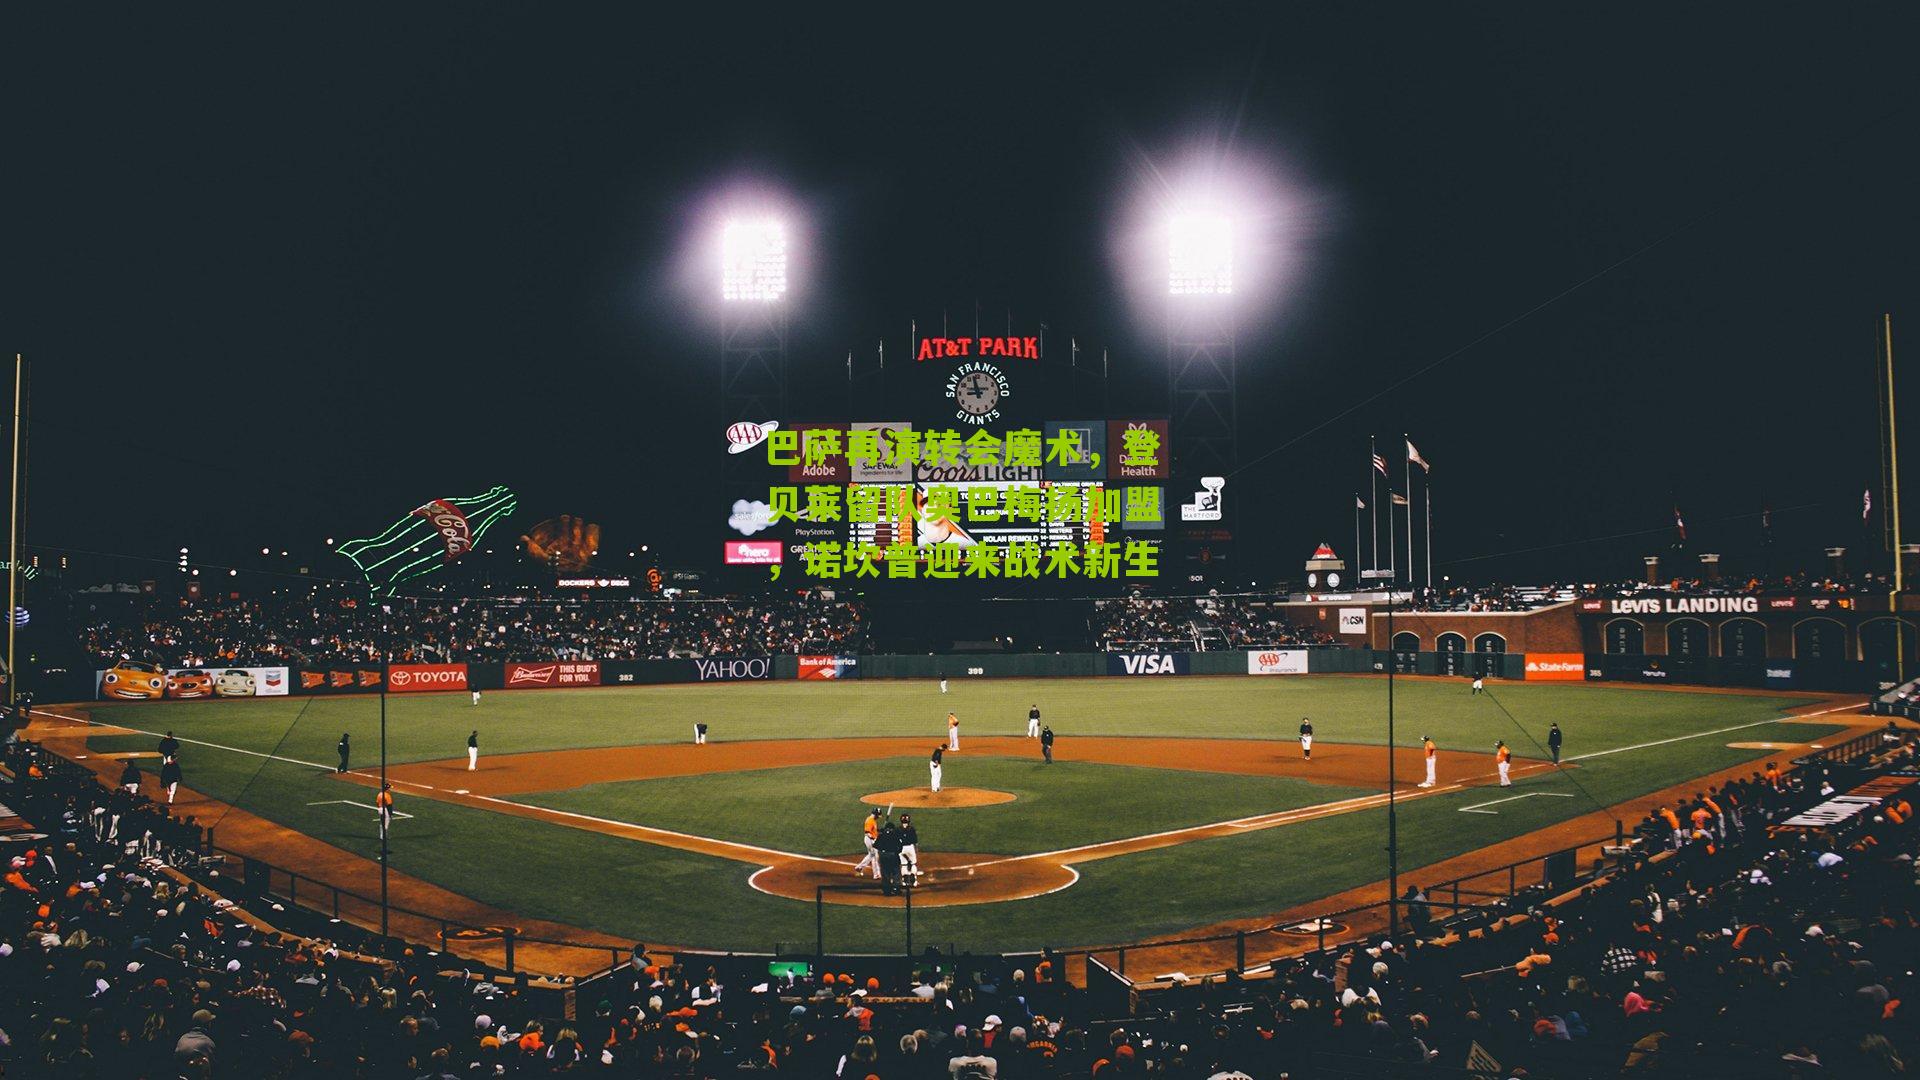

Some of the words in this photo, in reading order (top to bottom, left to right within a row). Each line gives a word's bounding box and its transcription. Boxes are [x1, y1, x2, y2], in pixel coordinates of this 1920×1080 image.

[918, 336, 972, 361] AT&T
[979, 336, 1039, 360] PARK
[957, 361, 1010, 397] FRANCISCO
[945, 373, 960, 398] SAN
[956, 409, 1001, 425] GIANTS
[802, 464, 836, 476] Adobe
[916, 459, 982, 482] Coors
[984, 465, 1043, 482] LIGHT
[1121, 466, 1156, 476] Health
[734, 511, 773, 522] salesfor
[795, 528, 835, 537] PlayStation
[982, 535, 1007, 543] NOLAN
[1008, 535, 1039, 543] REIMOLD
[1665, 597, 1758, 613] LANDING
[1349, 616, 1364, 625] CSN
[800, 658, 819, 666] Bank
[826, 657, 856, 666] America
[1119, 654, 1176, 674] VISA
[559, 665, 575, 673] THIS
[576, 664, 598, 673] BUD'S
[695, 659, 771, 681] YAHOO!
[413, 671, 467, 683] TOYOTA
[559, 674, 574, 682] FOR
[575, 673, 590, 682] YOU.
